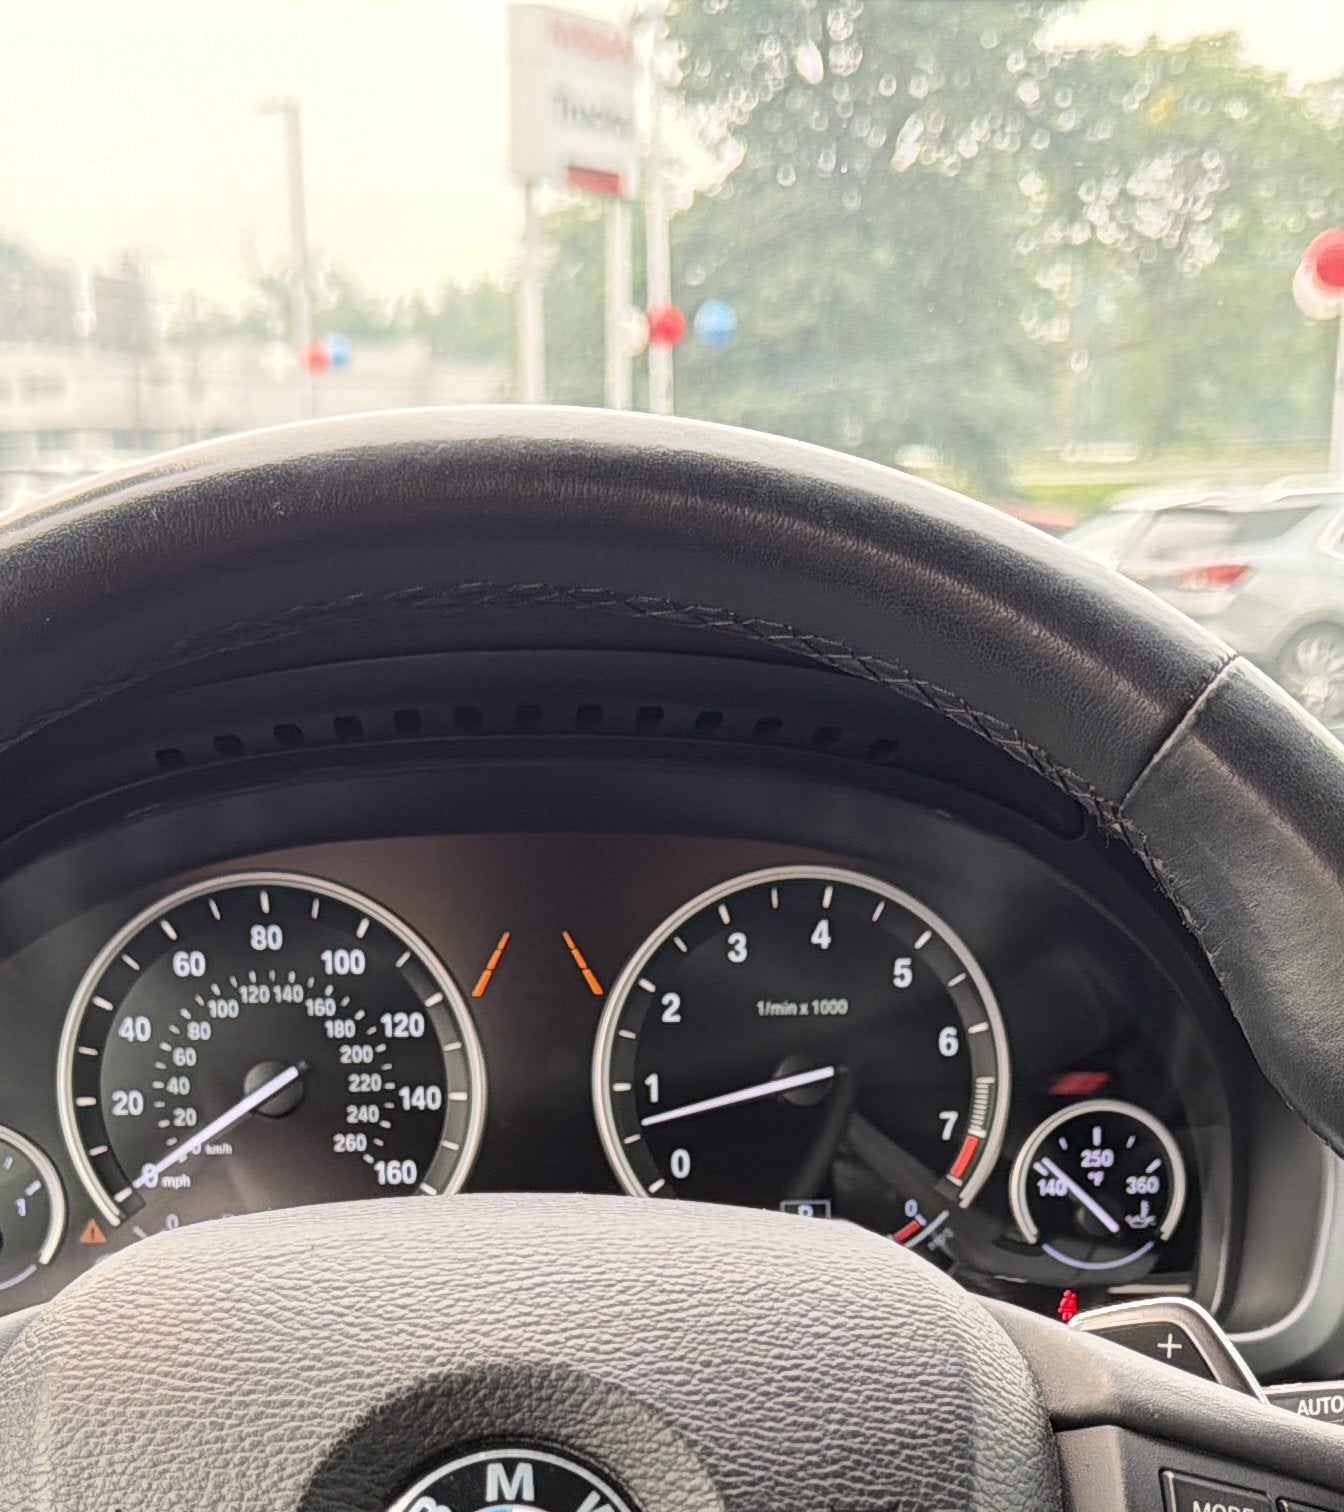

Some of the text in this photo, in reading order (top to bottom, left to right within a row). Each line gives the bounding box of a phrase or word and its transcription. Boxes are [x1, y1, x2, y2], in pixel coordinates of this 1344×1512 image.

[250, 924, 283, 951] 80
[811, 919, 831, 949] 4
[727, 933, 748, 962] 3
[173, 951, 206, 977] 60
[321, 950, 365, 975] 100
[893, 958, 912, 987] 5
[239, 985, 270, 1003] 120
[273, 984, 304, 1002] 140
[208, 1000, 239, 1018] 100
[306, 999, 336, 1016] 160
[661, 993, 681, 1023] 2
[757, 1000, 797, 1016] 1/min
[811, 999, 848, 1015] 1000
[118, 1016, 151, 1042] 40
[187, 1022, 211, 1040] 80
[325, 1020, 355, 1038] 180
[381, 1013, 425, 1038] 120
[938, 1027, 958, 1056] 6
[173, 1048, 196, 1066] 60
[339, 1046, 373, 1063] 200
[167, 1077, 190, 1095] 40
[348, 1074, 381, 1092] 220
[644, 1073, 659, 1102] 1
[112, 1091, 144, 1116] 20
[399, 1085, 442, 1110] 140
[173, 1109, 197, 1126] 20
[346, 1106, 379, 1123] 240
[939, 1110, 958, 1140] 7
[333, 1134, 366, 1152] 260
[670, 1149, 691, 1178] 0
[1081, 1149, 1114, 1168] 250
[374, 1160, 417, 1185] 160
[161, 1174, 191, 1190] mph
[1037, 1180, 1067, 1197] 140
[1125, 1176, 1159, 1194] 360
[16, 1198, 26, 1216] 1
[1297, 1395, 1344, 1416] AUTO
